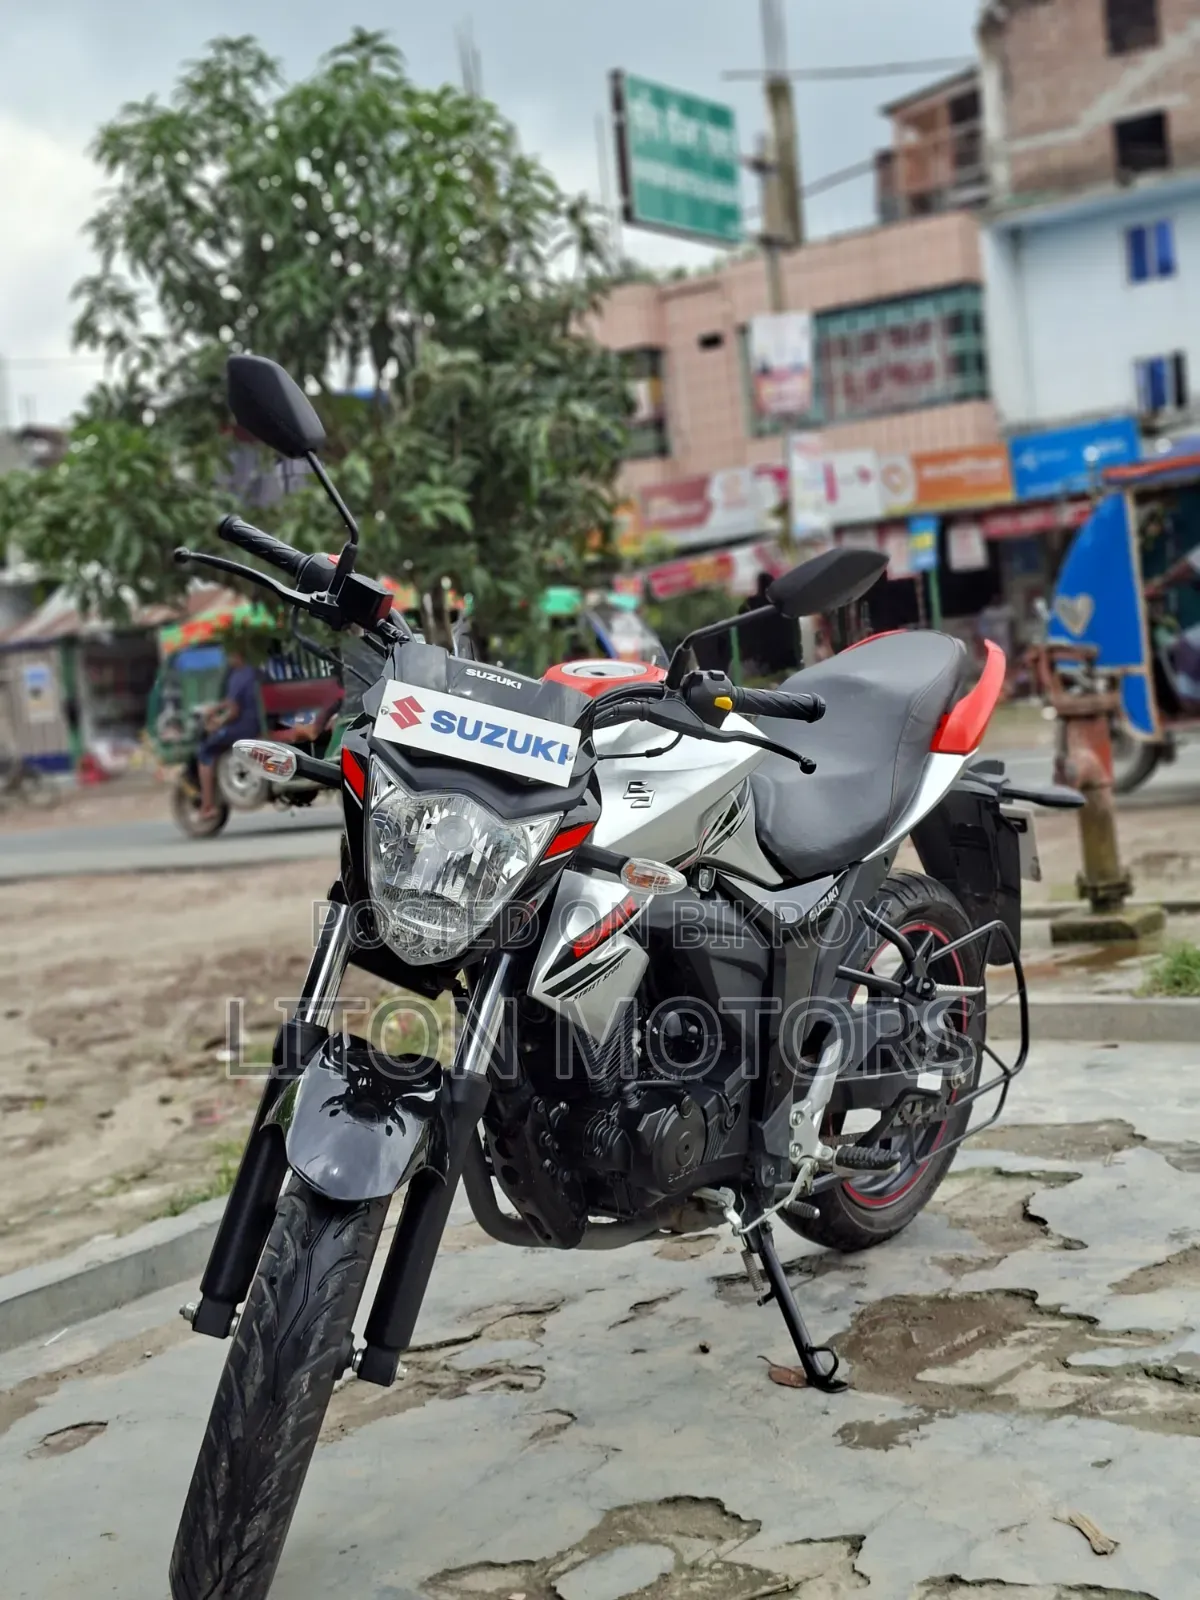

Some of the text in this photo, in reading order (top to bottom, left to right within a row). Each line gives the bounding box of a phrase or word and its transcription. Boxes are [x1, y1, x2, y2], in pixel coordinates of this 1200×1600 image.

[465, 667, 522, 690] SUZUKI
[430, 710, 570, 765] SUZUKI
[809, 885, 839, 922] SUZUKI
